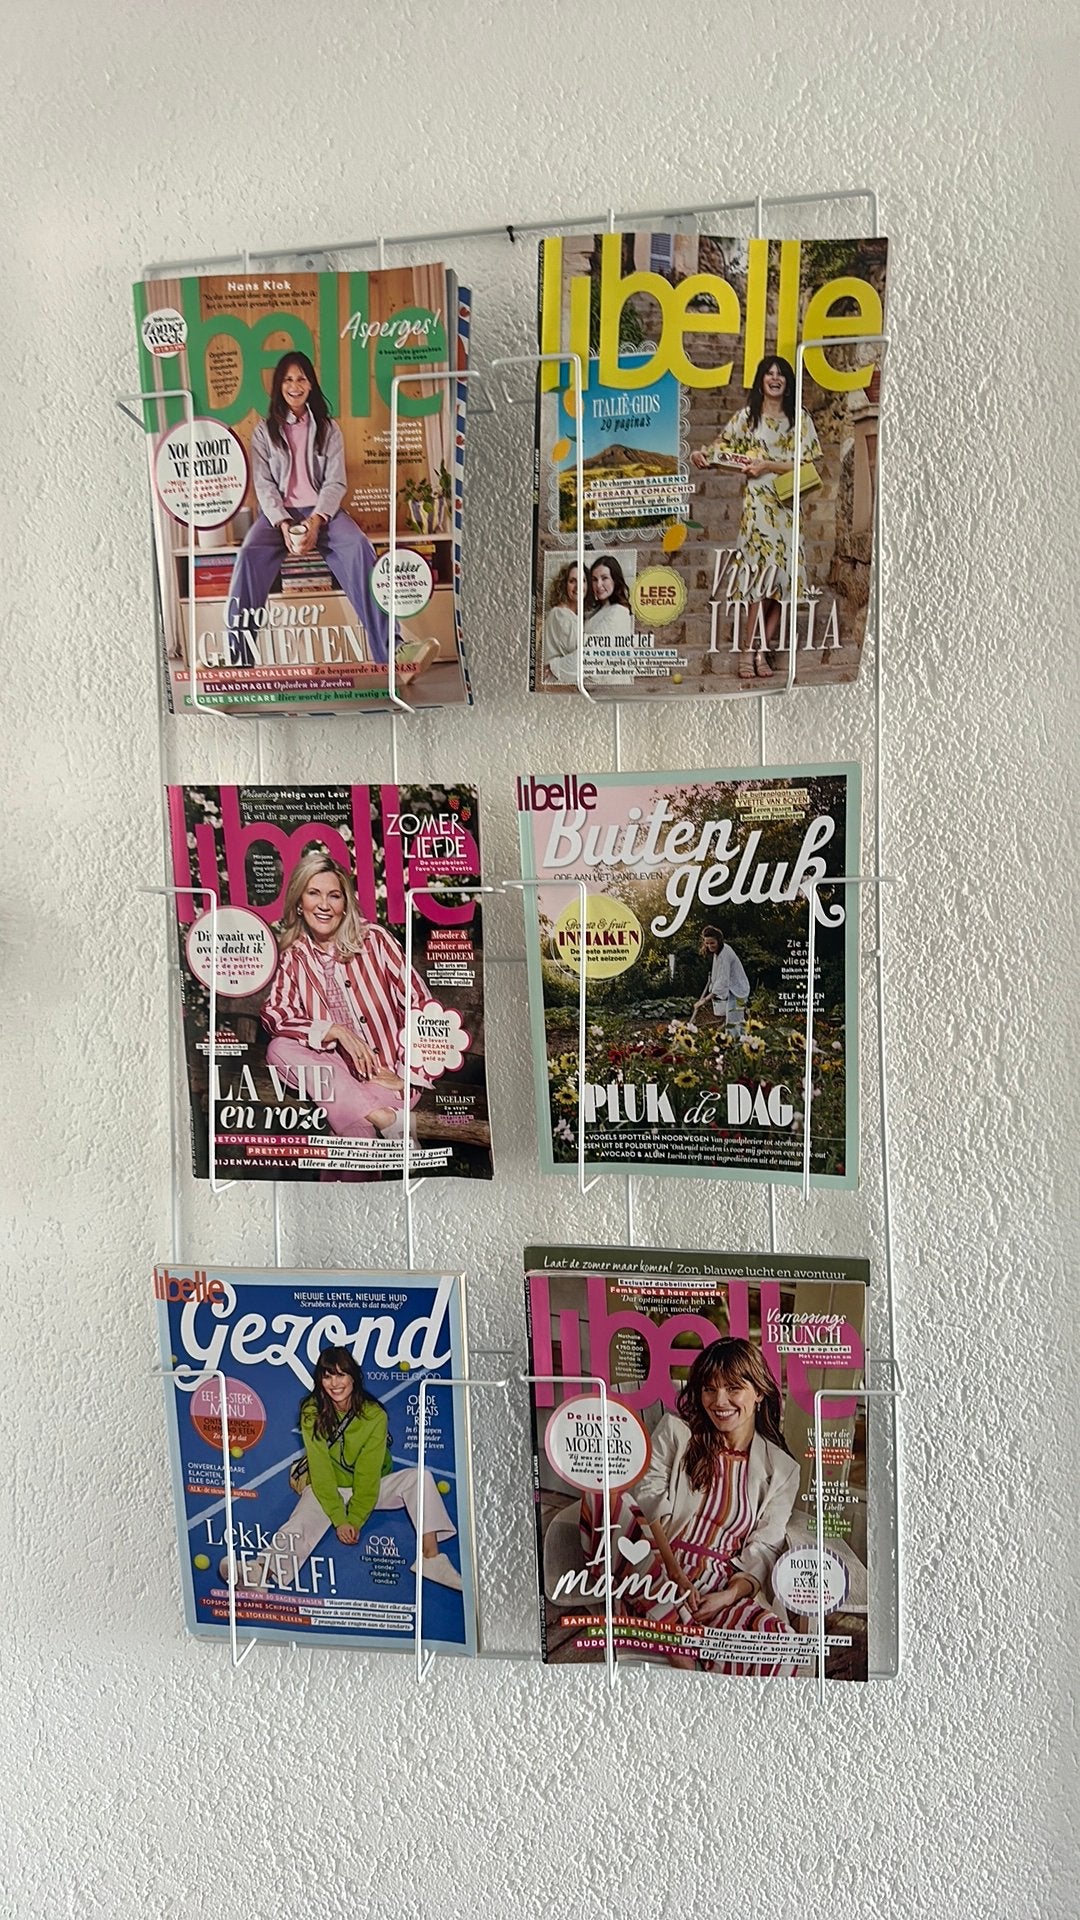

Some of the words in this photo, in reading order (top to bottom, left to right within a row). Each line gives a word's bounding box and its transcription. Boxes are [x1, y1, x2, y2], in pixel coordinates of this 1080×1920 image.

[227, 281, 260, 292] Hans
[263, 280, 291, 290] Klok
[541, 233, 883, 392] libelle
[340, 308, 441, 348] Asperges!
[591, 392, 661, 419] ITALIË-GIDS
[600, 418, 612, 432] 29
[195, 438, 231, 458] NOOIT
[646, 476, 687, 485] SALERNO
[592, 489, 632, 498] FERRARA
[641, 485, 694, 495] COMACCHIO
[637, 505, 688, 515] STROMBOLI
[379, 557, 422, 574] Stakker
[711, 548, 778, 598] Viva
[376, 580, 428, 589] SPOTSCHOOL
[640, 586, 677, 598] LEES
[223, 597, 326, 630] Groener
[707, 599, 843, 653] ITALIA
[614, 634, 634, 648] met
[638, 631, 654, 648] lef
[197, 624, 366, 668] GENIETEN
[176, 672, 190, 680] DE
[206, 682, 272, 692] EILANDMAGIE
[228, 694, 276, 703] SKINCARE
[280, 790, 307, 800] Helga
[516, 775, 598, 812] libelle
[386, 813, 465, 836] ZOMER
[543, 800, 740, 869] Buiten
[404, 836, 467, 859] LIEFDE
[611, 871, 663, 881] LANDLEVEN
[650, 815, 845, 938] geluk
[608, 918, 631, 930] fruit
[216, 930, 245, 942] waait
[247, 930, 265, 942] wel
[431, 930, 460, 939] Moeder
[460, 930, 468, 940] &
[559, 930, 640, 946] INMAKEN
[221, 943, 250, 954] dacht
[428, 941, 457, 950] dochter
[787, 940, 801, 948] Zie
[426, 952, 474, 961] LIPOEDEEM
[790, 949, 808, 957] een
[417, 1015, 450, 1026] Groene
[417, 1026, 451, 1037] WINST
[209, 1064, 261, 1102] LA
[266, 1064, 335, 1102] VIE
[584, 1083, 676, 1123] PLUK
[684, 1090, 721, 1124] de
[727, 1083, 794, 1127] DAG
[220, 1105, 256, 1129] en
[263, 1106, 327, 1130] roze
[280, 1136, 307, 1144] ROZE
[309, 1137, 324, 1145] Het
[289, 1147, 300, 1155] IN
[303, 1148, 328, 1156] PINK
[644, 1150, 666, 1158] ALUIN
[300, 1160, 325, 1168] Alleen
[327, 1160, 338, 1168] de
[339, 1160, 390, 1169] allermooiste
[544, 1255, 568, 1269] Laat
[569, 1258, 580, 1269] de
[582, 1261, 611, 1270] zomer
[612, 1263, 640, 1271] maar
[640, 1260, 674, 1273] komen!
[704, 1265, 744, 1276] blauwe
[746, 1266, 775, 1277] lucht
[777, 1269, 792, 1278] en
[794, 1270, 847, 1280] avontuur
[153, 1268, 225, 1304] libelle
[619, 1279, 653, 1287] Exclusief
[610, 1286, 638, 1294] Femke
[293, 1291, 325, 1300] NIEUWE
[355, 1293, 386, 1302] NIEUWE
[388, 1294, 408, 1302] HUID
[691, 1297, 706, 1306] heb
[707, 1297, 715, 1306] ik
[650, 1305, 668, 1313] mijn
[767, 1308, 847, 1332] Verrassings
[174, 1275, 452, 1393] Gezond
[767, 1323, 842, 1345] BRUNCH
[366, 1371, 390, 1381] 100%
[426, 1395, 436, 1405] DE
[567, 1412, 582, 1420] De
[188, 1469, 222, 1479] KLACHTEN,
[206, 1478, 220, 1486] DAG
[205, 1518, 301, 1552] Lekker
[369, 1535, 395, 1547] OOK
[365, 1544, 379, 1555] IN
[586, 1525, 622, 1567] I
[226, 1549, 337, 1595] JEZELF!
[551, 1569, 691, 1605] mama
[563, 1617, 600, 1626] SAMEN
[660, 1623, 671, 1631] IN
[675, 1626, 704, 1635] GENT
[706, 1628, 747, 1640] Hotspots,
[750, 1632, 790, 1642] winkelen
[792, 1635, 804, 1643] en
[830, 1637, 850, 1645] eten
[590, 1628, 627, 1636] SAEN
[631, 1629, 681, 1643] SHOPPEN
[683, 1637, 696, 1645] De
[698, 1639, 710, 1647] 23
[712, 1641, 768, 1652] allermooiste
[576, 1639, 653, 1649] BUDGTPROOF
[658, 1644, 699, 1656] STYLEN
[702, 1649, 754, 1663] Opfrisbeurt
[756, 1655, 777, 1663] voor
[778, 1656, 788, 1665] je
[790, 1656, 809, 1664] huis
